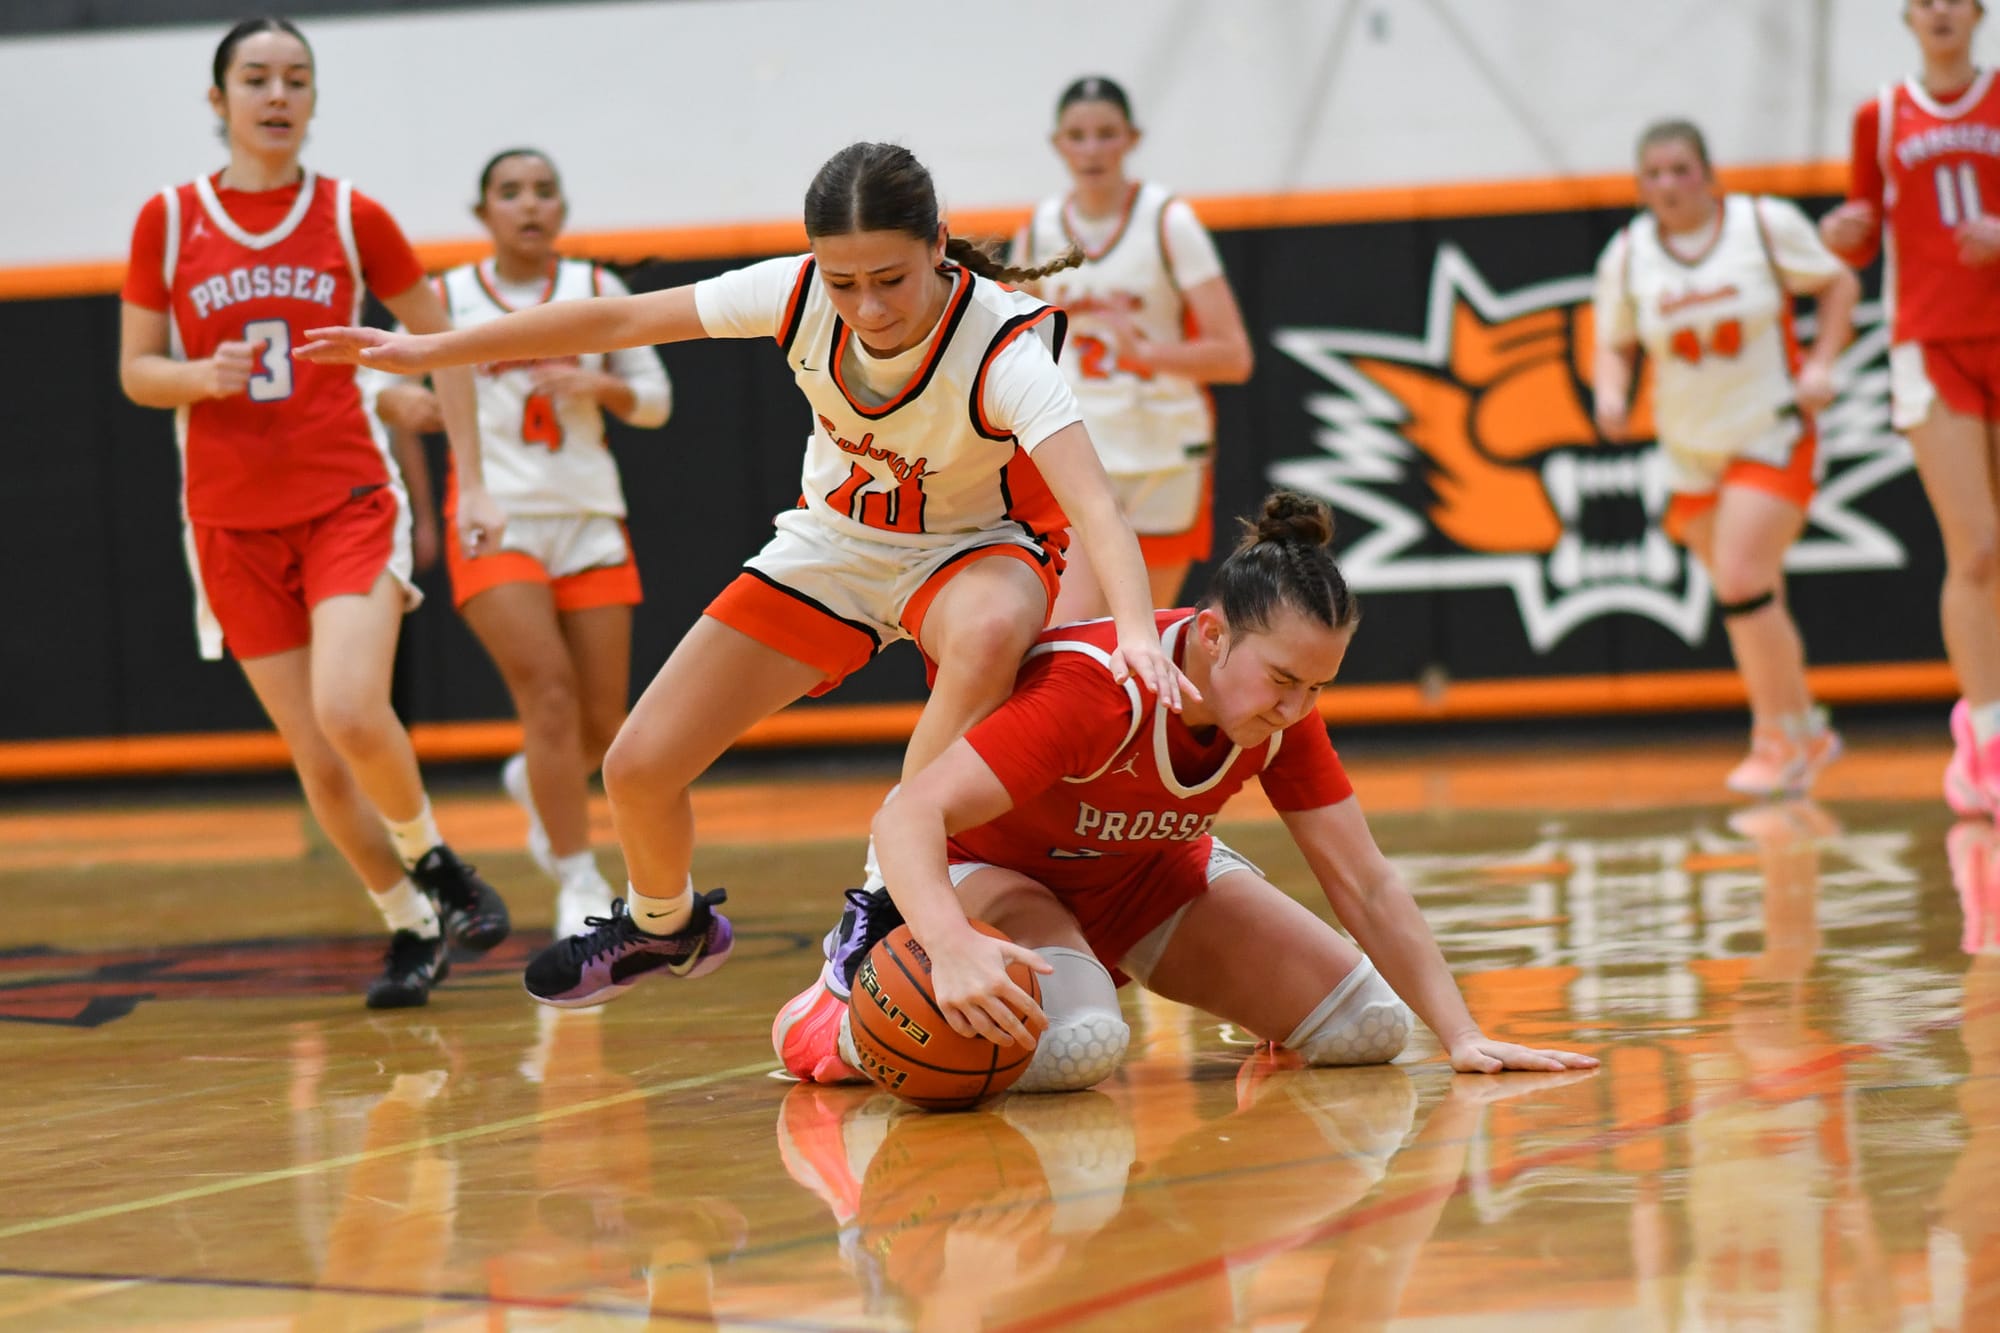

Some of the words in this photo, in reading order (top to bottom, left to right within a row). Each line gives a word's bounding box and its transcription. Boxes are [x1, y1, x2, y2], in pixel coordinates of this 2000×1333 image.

[1933, 161, 1983, 228] 11
[188, 263, 337, 320] PROSSER
[243, 316, 295, 403] 3
[521, 392, 565, 455] 4
[1074, 800, 1218, 843] PROSSE
[863, 973, 933, 1049] ELITE
